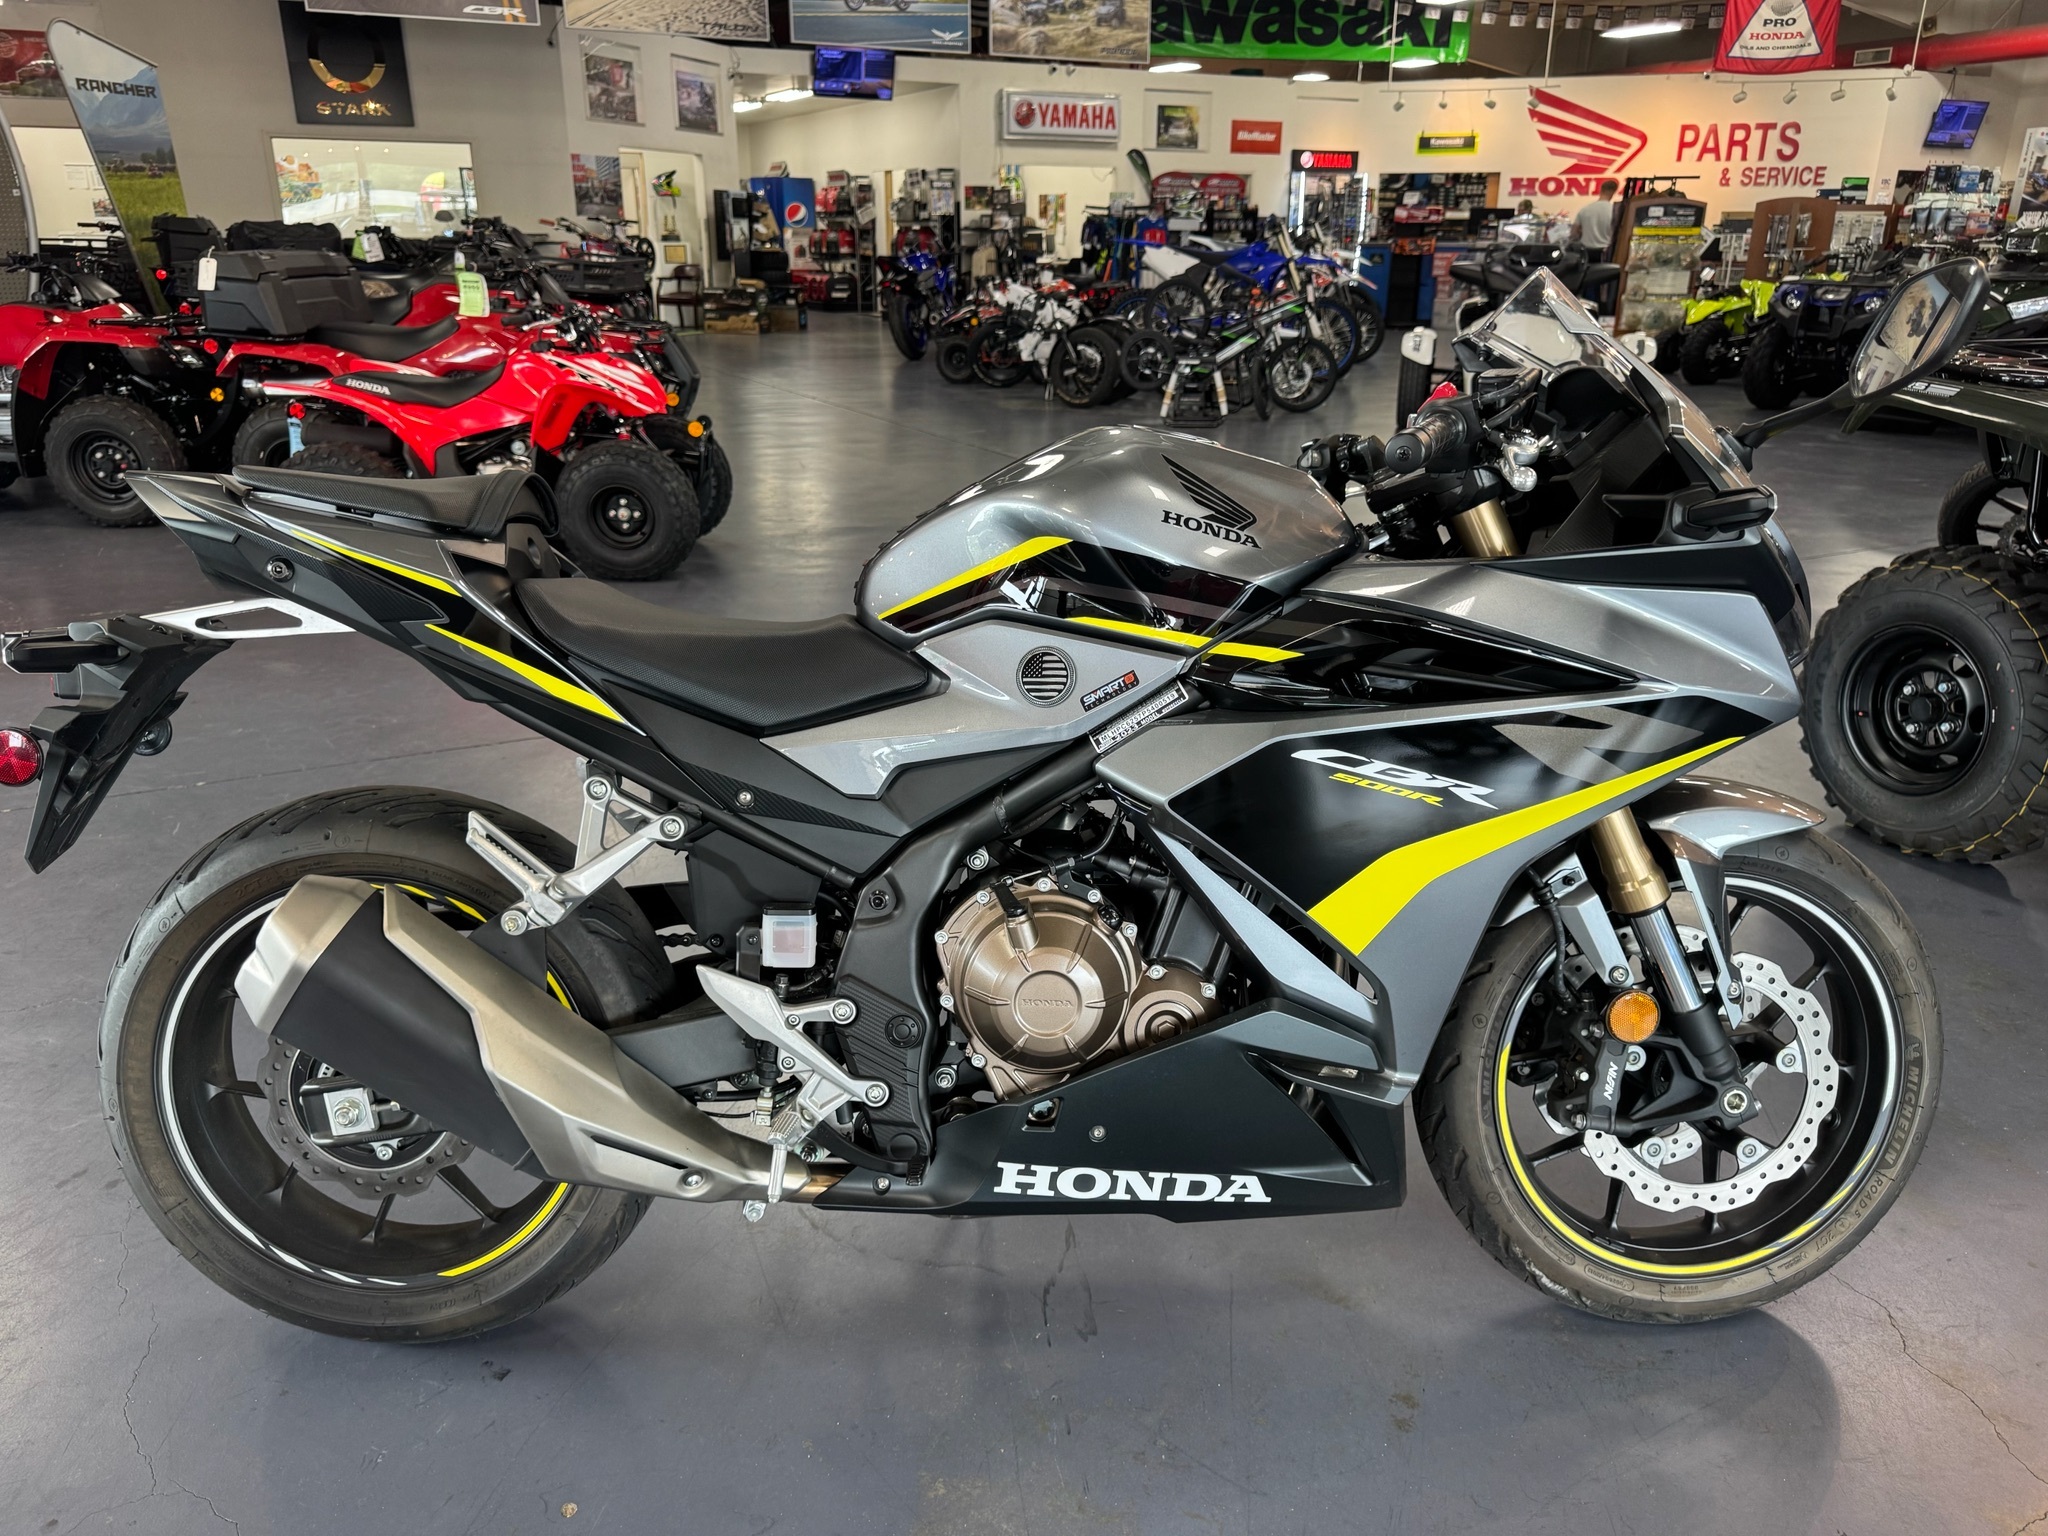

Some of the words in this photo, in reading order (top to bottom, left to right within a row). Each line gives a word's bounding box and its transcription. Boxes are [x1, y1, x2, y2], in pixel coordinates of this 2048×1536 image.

[463, 4, 527, 18] CBR
[698, 21, 761, 34] TALON
[1763, 17, 1797, 28] PRO
[1748, 31, 1805, 41] HONDA
[1771, 42, 1812, 51] CHEMICALS
[75, 77, 158, 99] RANCHER
[316, 100, 393, 117] STARK
[1038, 102, 1117, 130] YAMAHA
[1676, 121, 1802, 163] PARTS
[1313, 153, 1353, 168] YAMAHA
[1508, 176, 1624, 197] HOND
[1719, 168, 1731, 187] &
[1740, 165, 1828, 187] SERVICE
[346, 378, 391, 395] HONDA
[1161, 509, 1262, 549] HONDA
[1085, 681, 1138, 709] TECHNOLOGY
[1140, 711, 1161, 727] MODEL
[1291, 749, 1500, 810] CBR
[1328, 772, 1444, 808] 500R
[1022, 999, 1073, 1008] HONDA
[1884, 1065, 1920, 1166] MICHELIN
[993, 1161, 1272, 1203] HONDA
[1859, 1176, 1884, 1210] ROAD
[1815, 1231, 1836, 1252] 2CT
